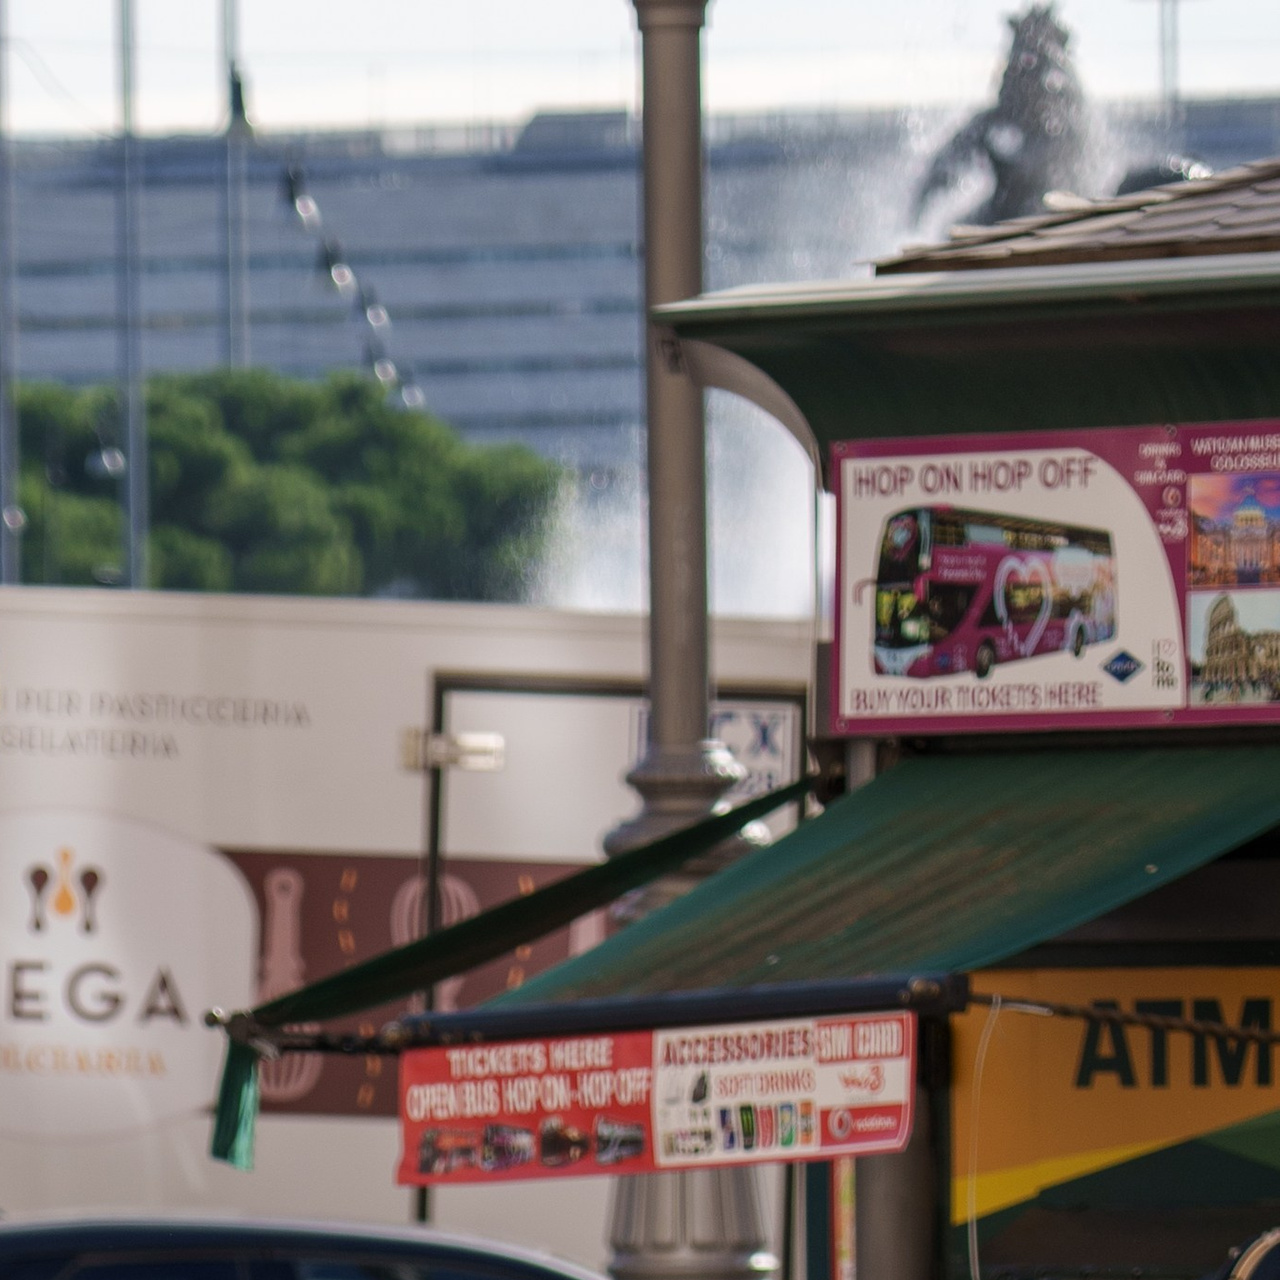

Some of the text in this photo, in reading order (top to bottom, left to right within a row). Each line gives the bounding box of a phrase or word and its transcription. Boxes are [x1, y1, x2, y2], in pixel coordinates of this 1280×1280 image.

[1191, 437, 1247, 455] VATICAN
[855, 456, 1097, 496] HOP ON HOP OFF
[852, 681, 1102, 711] BUY YOUR TICKETS HERE
[447, 1037, 613, 1078] TICKETS HERE
[663, 1028, 811, 1065] ACCESSORIES
[820, 1021, 902, 1060] SIM CARD
[1074, 997, 1274, 1088] ATM
[406, 1084, 457, 1121] OPEN
[458, 1079, 500, 1117] BUS
[502, 1075, 538, 1114] HOP
[614, 1067, 651, 1105] OFF
[715, 1074, 755, 1097] SOFT
[758, 1069, 815, 1094] DRINKS
